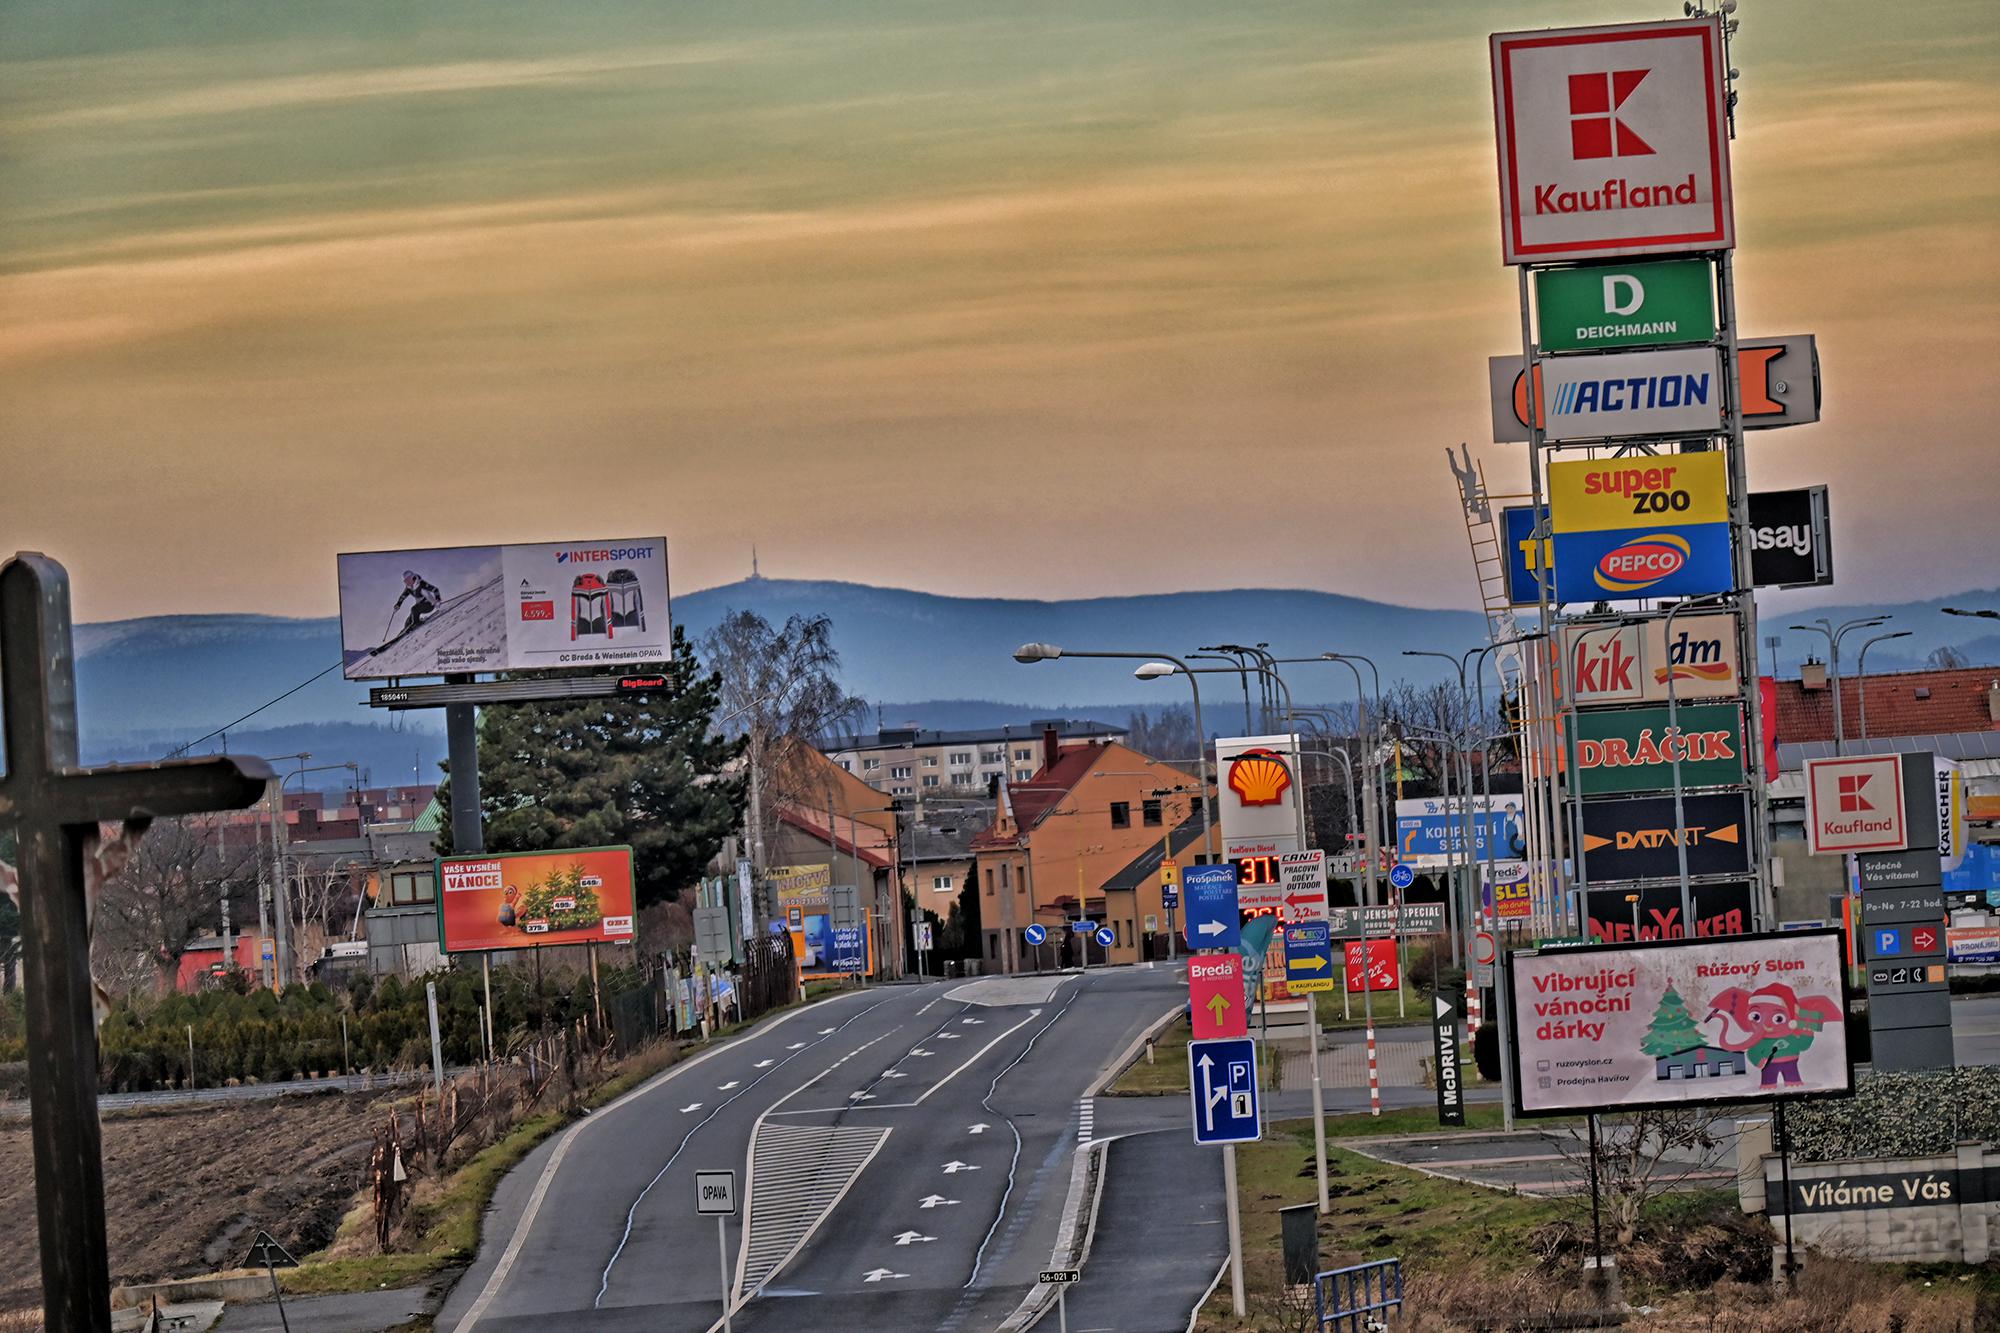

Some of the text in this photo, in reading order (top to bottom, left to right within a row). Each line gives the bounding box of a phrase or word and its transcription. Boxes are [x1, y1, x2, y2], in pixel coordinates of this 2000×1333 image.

[1535, 173, 1696, 215] Kaufland
[1602, 274, 1645, 317] D
[1576, 321, 1677, 340] DEICHMANN
[1573, 373, 1710, 415] ACTION
[1584, 466, 1677, 499] super
[570, 547, 653, 562] INTERSPORT
[1608, 551, 1677, 573] PEPCO
[571, 653, 593, 661] Breda
[601, 650, 638, 659] Weinstein
[639, 650, 662, 658] OPAVA
[1670, 632, 1721, 665] dm
[622, 679, 662, 688] BigBoard
[1577, 726, 1736, 769] DRÁČIK
[1938, 770, 1951, 858] KÄRCHER
[1824, 818, 1893, 835] Kaufland
[1616, 826, 1706, 850] DATART
[1282, 852, 1322, 862] CANIS
[444, 862, 502, 873] VAŠE VYSNĚNÉ
[1284, 864, 1320, 874] PRACOVNÍ
[1866, 873, 1883, 881] Vás
[448, 874, 499, 889] VÁNOCE
[1287, 881, 1321, 891] OUTDOOR
[1866, 902, 1895, 911] Po-Ne
[1900, 900, 1921, 909] 7-22
[1923, 899, 1943, 908] hod.
[1882, 933, 1894, 950] P
[1191, 963, 1233, 978] Breda
[1697, 958, 1805, 978] Růžový Slon
[1532, 968, 1636, 993] Vibrující
[1534, 992, 1632, 1017] vánoční
[1536, 1019, 1606, 1042] dárky
[1233, 1065, 1246, 1084] P
[1439, 1024, 1457, 1106] McDRIVE
[1557, 1076, 1596, 1086] Prodejna
[703, 1185, 728, 1200] OPAVA
[1799, 1175, 1951, 1207] Vítáme Vás
[1040, 1272, 1067, 1282] 56-021
